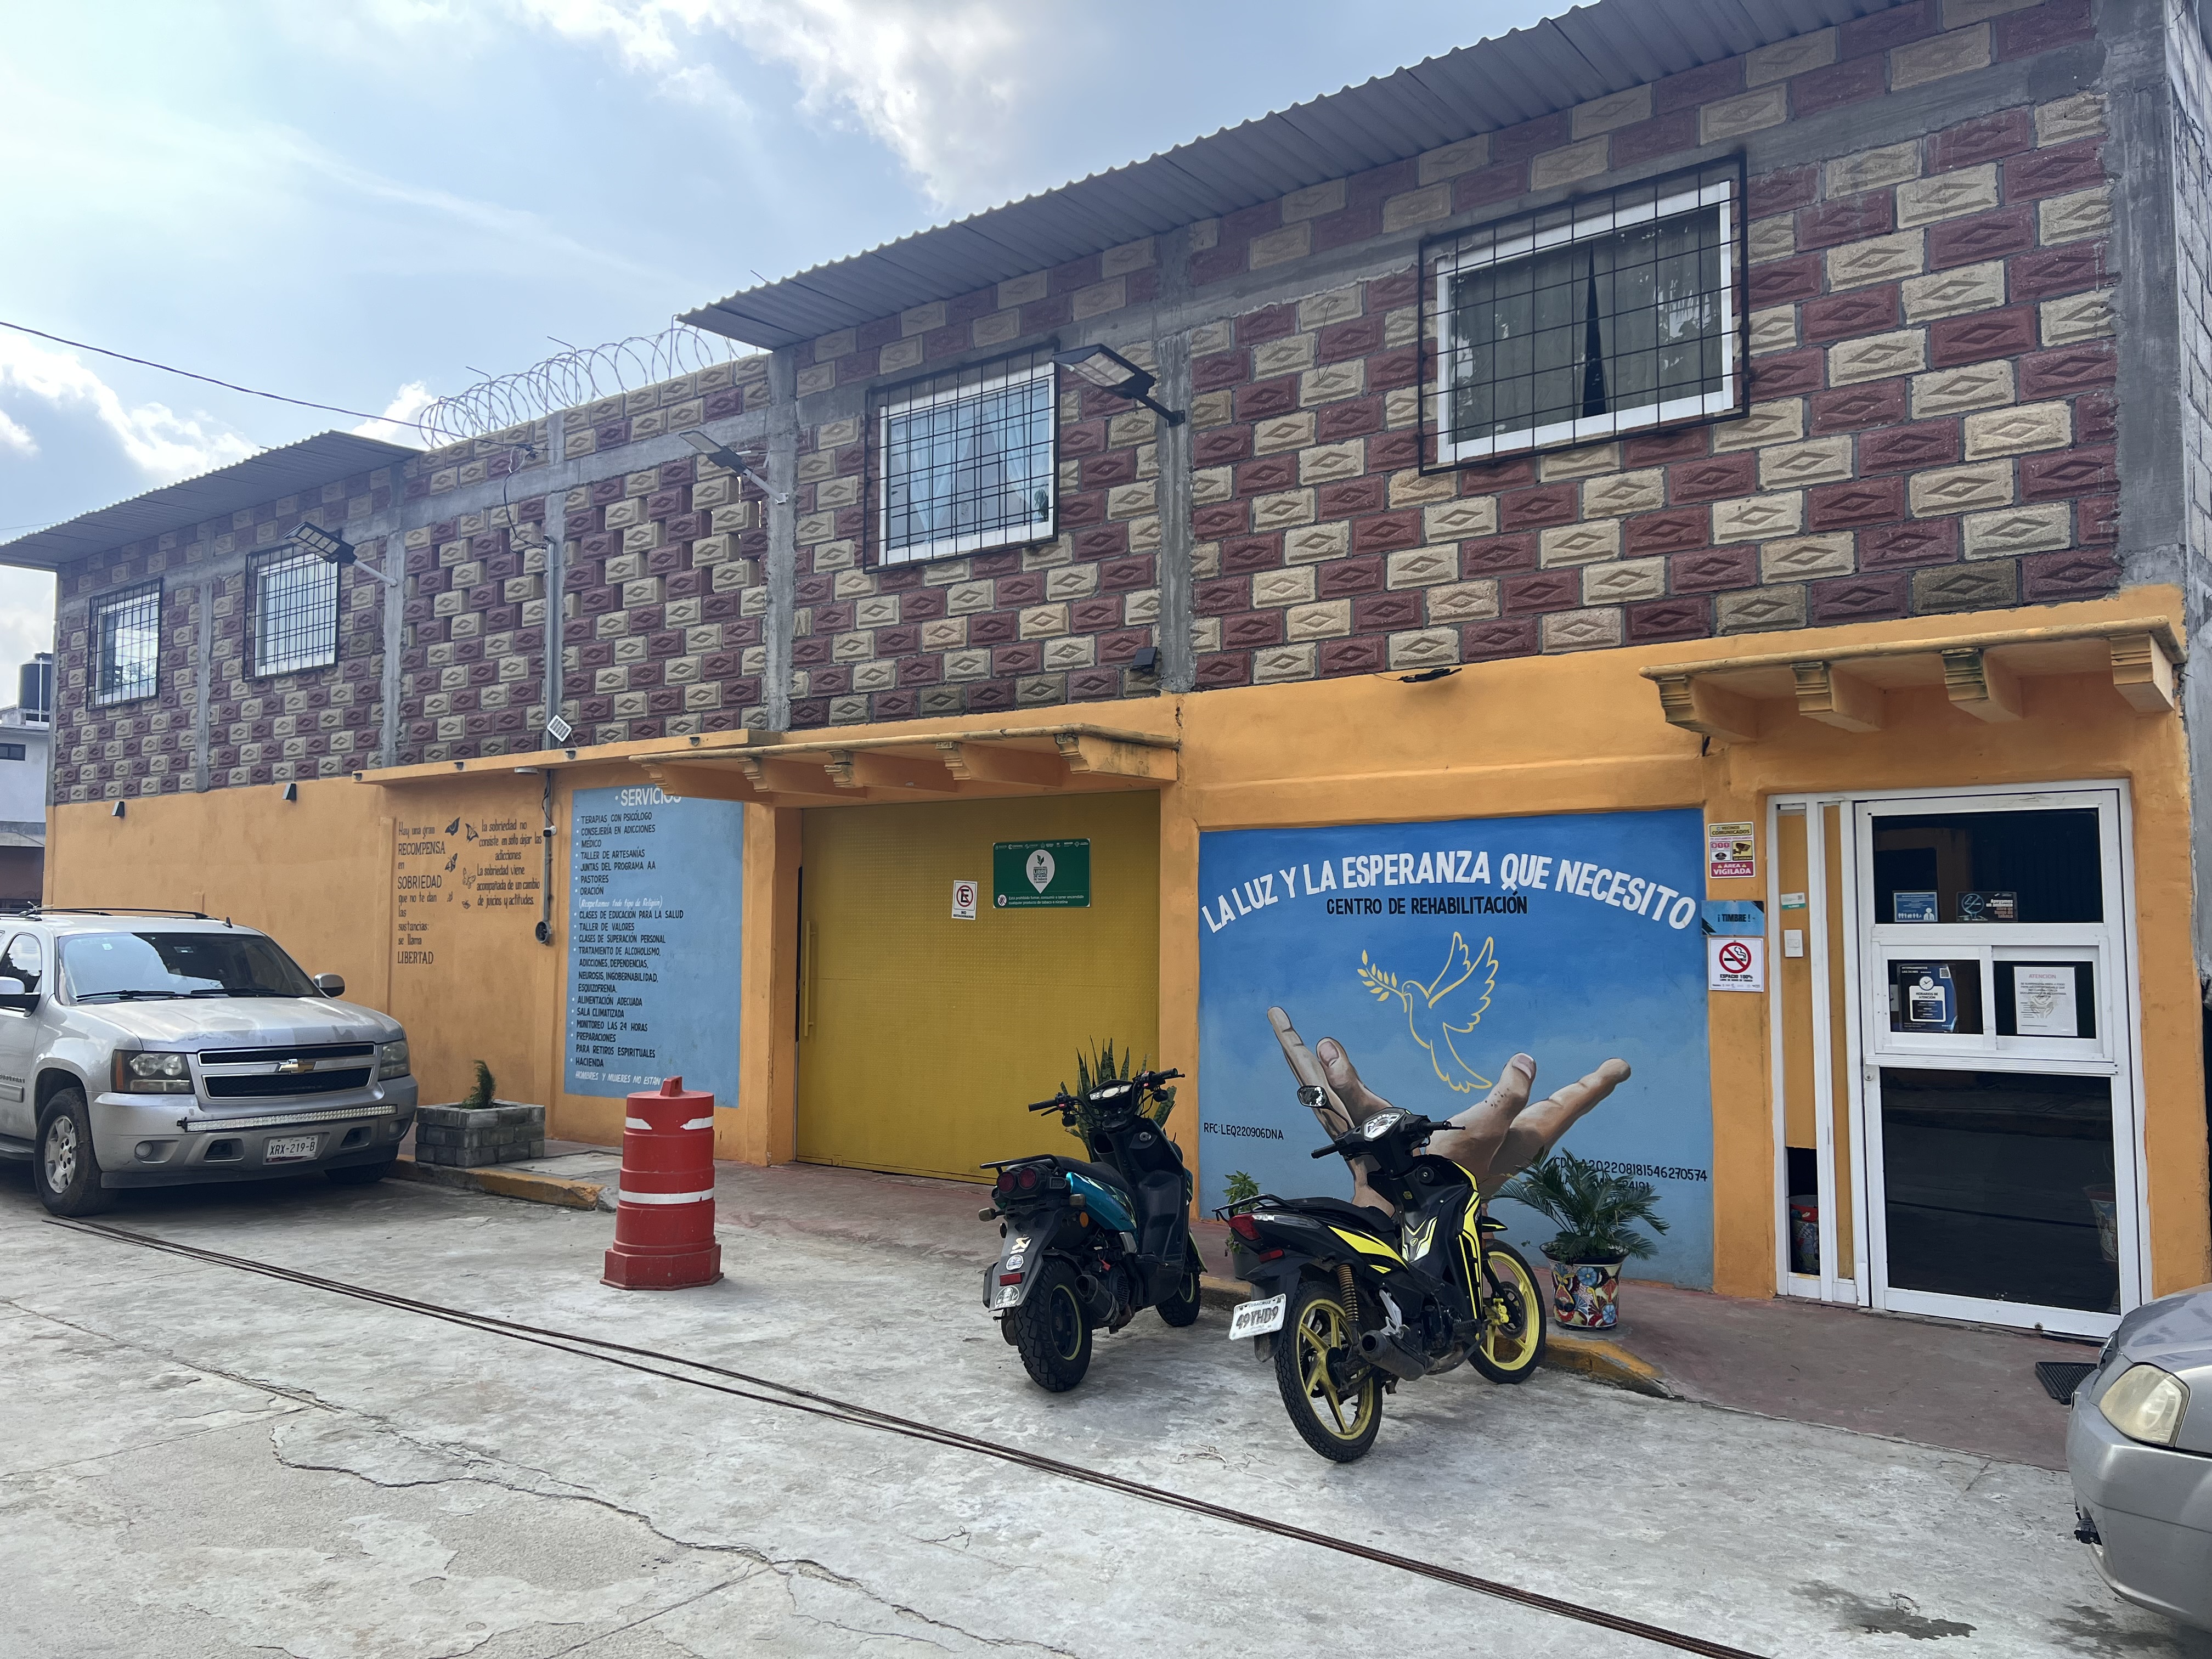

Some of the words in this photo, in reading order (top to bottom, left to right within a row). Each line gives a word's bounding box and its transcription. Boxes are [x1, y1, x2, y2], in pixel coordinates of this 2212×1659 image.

[581, 815, 607, 824] TERAPIAS
[624, 810, 652, 821] PSICÓLOGO
[399, 822, 409, 839] Hay
[412, 827, 421, 835] una
[422, 826, 435, 839] gran
[489, 819, 517, 831] sobriedad
[581, 824, 612, 836] CONSEJERÍA
[614, 826, 621, 834] EN
[624, 825, 656, 834] ADICCIONES
[479, 835, 499, 847] consiste
[520, 834, 532, 847] dejar
[582, 837, 601, 848] MÉDICO
[398, 841, 445, 855] RECOMPENSA
[581, 851, 599, 860] TALLER
[612, 847, 645, 859] ARTESANÍAS
[495, 849, 521, 861] adicciones
[477, 864, 483, 876] La
[484, 864, 508, 876] sobriedad
[511, 865, 524, 875] viene
[580, 863, 599, 871] JUNTAS
[601, 862, 611, 871] DEL
[614, 862, 644, 870] PROGRAMA
[647, 861, 656, 870] AA
[398, 875, 442, 889] SOBRIEDAD
[581, 875, 608, 883] PASTORES
[477, 879, 506, 893] acompañada
[507, 879, 514, 890] de
[523, 878, 540, 889] cambio
[580, 884, 604, 895] ORACIÓN
[1201, 895, 1236, 933] LA
[1231, 873, 1278, 916] LUZ
[1279, 866, 1296, 899] Y
[1302, 860, 1337, 895] LA
[1342, 850, 1491, 889] ESPERANZA
[1501, 853, 1553, 891] QUE
[1555, 859, 1696, 930] NECESITO
[398, 895, 407, 906] que
[419, 891, 425, 902] te
[427, 891, 437, 902] dan
[961, 889, 969, 902] E
[478, 895, 483, 906] de
[486, 895, 501, 909] juicios
[504, 898, 507, 909] y
[1327, 898, 1382, 915] CENTRO
[1389, 898, 1406, 915] DE
[1411, 891, 1527, 915] REHABILITACIÓN
[398, 906, 407, 917] las
[600, 911, 606, 919] DE
[609, 907, 636, 919] EDUCACIÓN
[639, 911, 652, 919] PARA
[654, 910, 662, 919] LA
[665, 910, 684, 918] SALUD
[612, 923, 634, 931] VALORES
[408, 934, 422, 945] llama
[607, 932, 637, 943] SUPERACIÓN
[641, 935, 665, 943] PERSONAL
[579, 946, 613, 955] TRATAMIENTO
[616, 947, 622, 955] DE
[398, 951, 433, 964] LIBERTAD
[578, 994, 613, 1005] ALIMENTACIÓN
[617, 997, 642, 1006] ADECUADA
[577, 1008, 590, 1016] SALA
[592, 1008, 624, 1018] CLIMATIZADA
[577, 1020, 604, 1029] MONITOREO
[608, 1022, 617, 1030] LAS
[620, 1022, 627, 1030] 24
[631, 1023, 648, 1031] HORAS
[577, 1032, 616, 1042] PREPARACIONES
[576, 1044, 590, 1053] PARA
[593, 1046, 614, 1055] RETIROS
[618, 1047, 655, 1058] ESPIRITUALES
[575, 1057, 604, 1067] HACIENDA
[575, 1070, 599, 1080] HOMBRES
[602, 1073, 606, 1081] Y
[607, 1073, 631, 1084] MUJERES
[633, 1076, 641, 1084] NO
[270, 1141, 315, 1155] XRX-219-B
